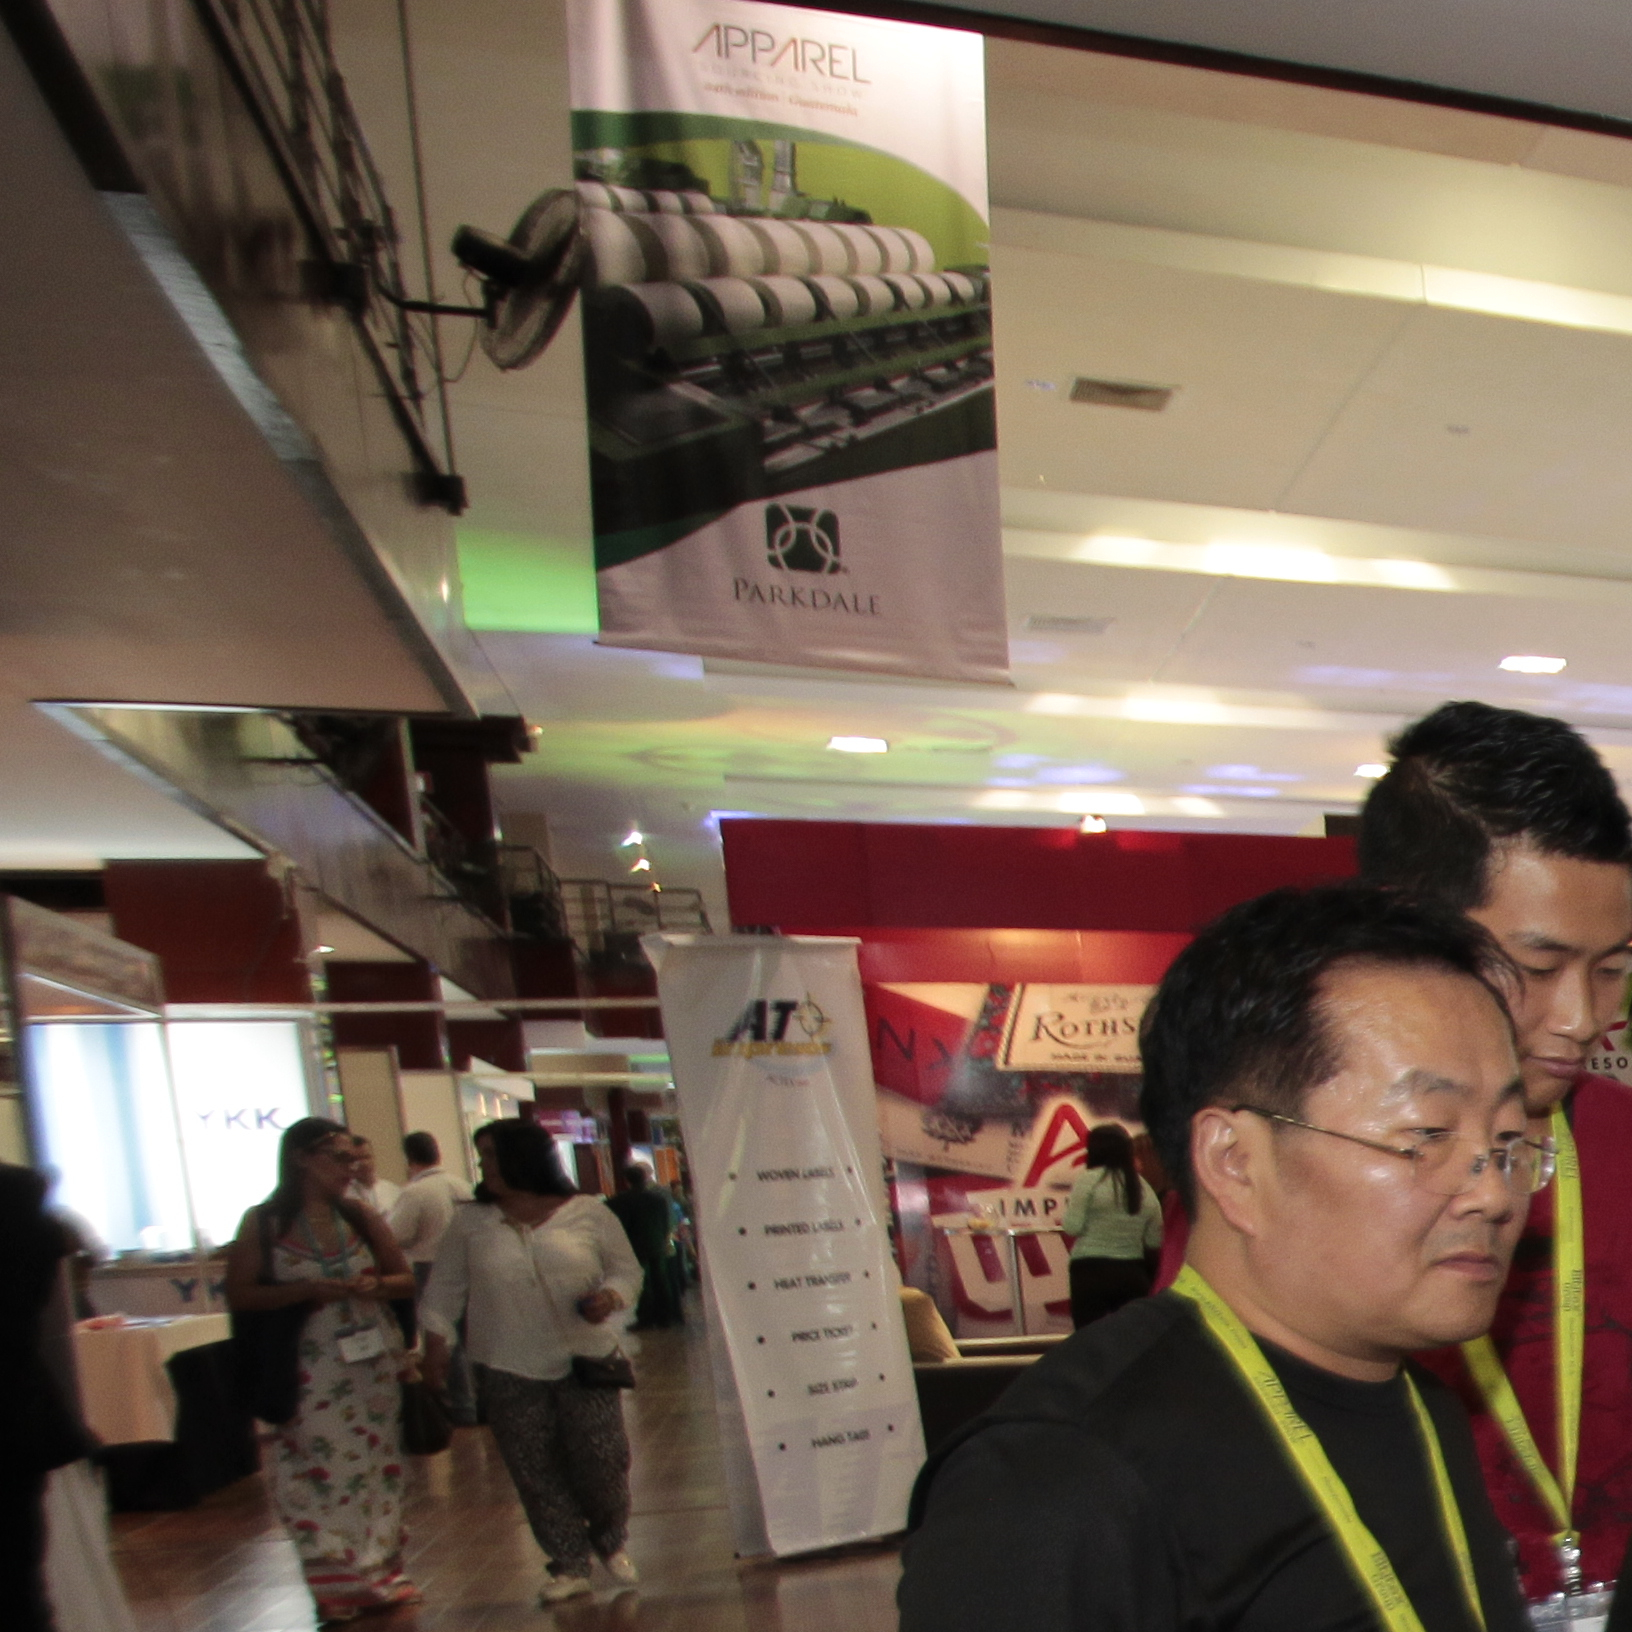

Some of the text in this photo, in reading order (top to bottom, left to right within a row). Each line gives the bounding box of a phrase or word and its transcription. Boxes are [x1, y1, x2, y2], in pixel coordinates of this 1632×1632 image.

[692, 22, 871, 84] APPAREL
[733, 577, 882, 616] PARKDALE
[195, 1107, 287, 1131] YKK
